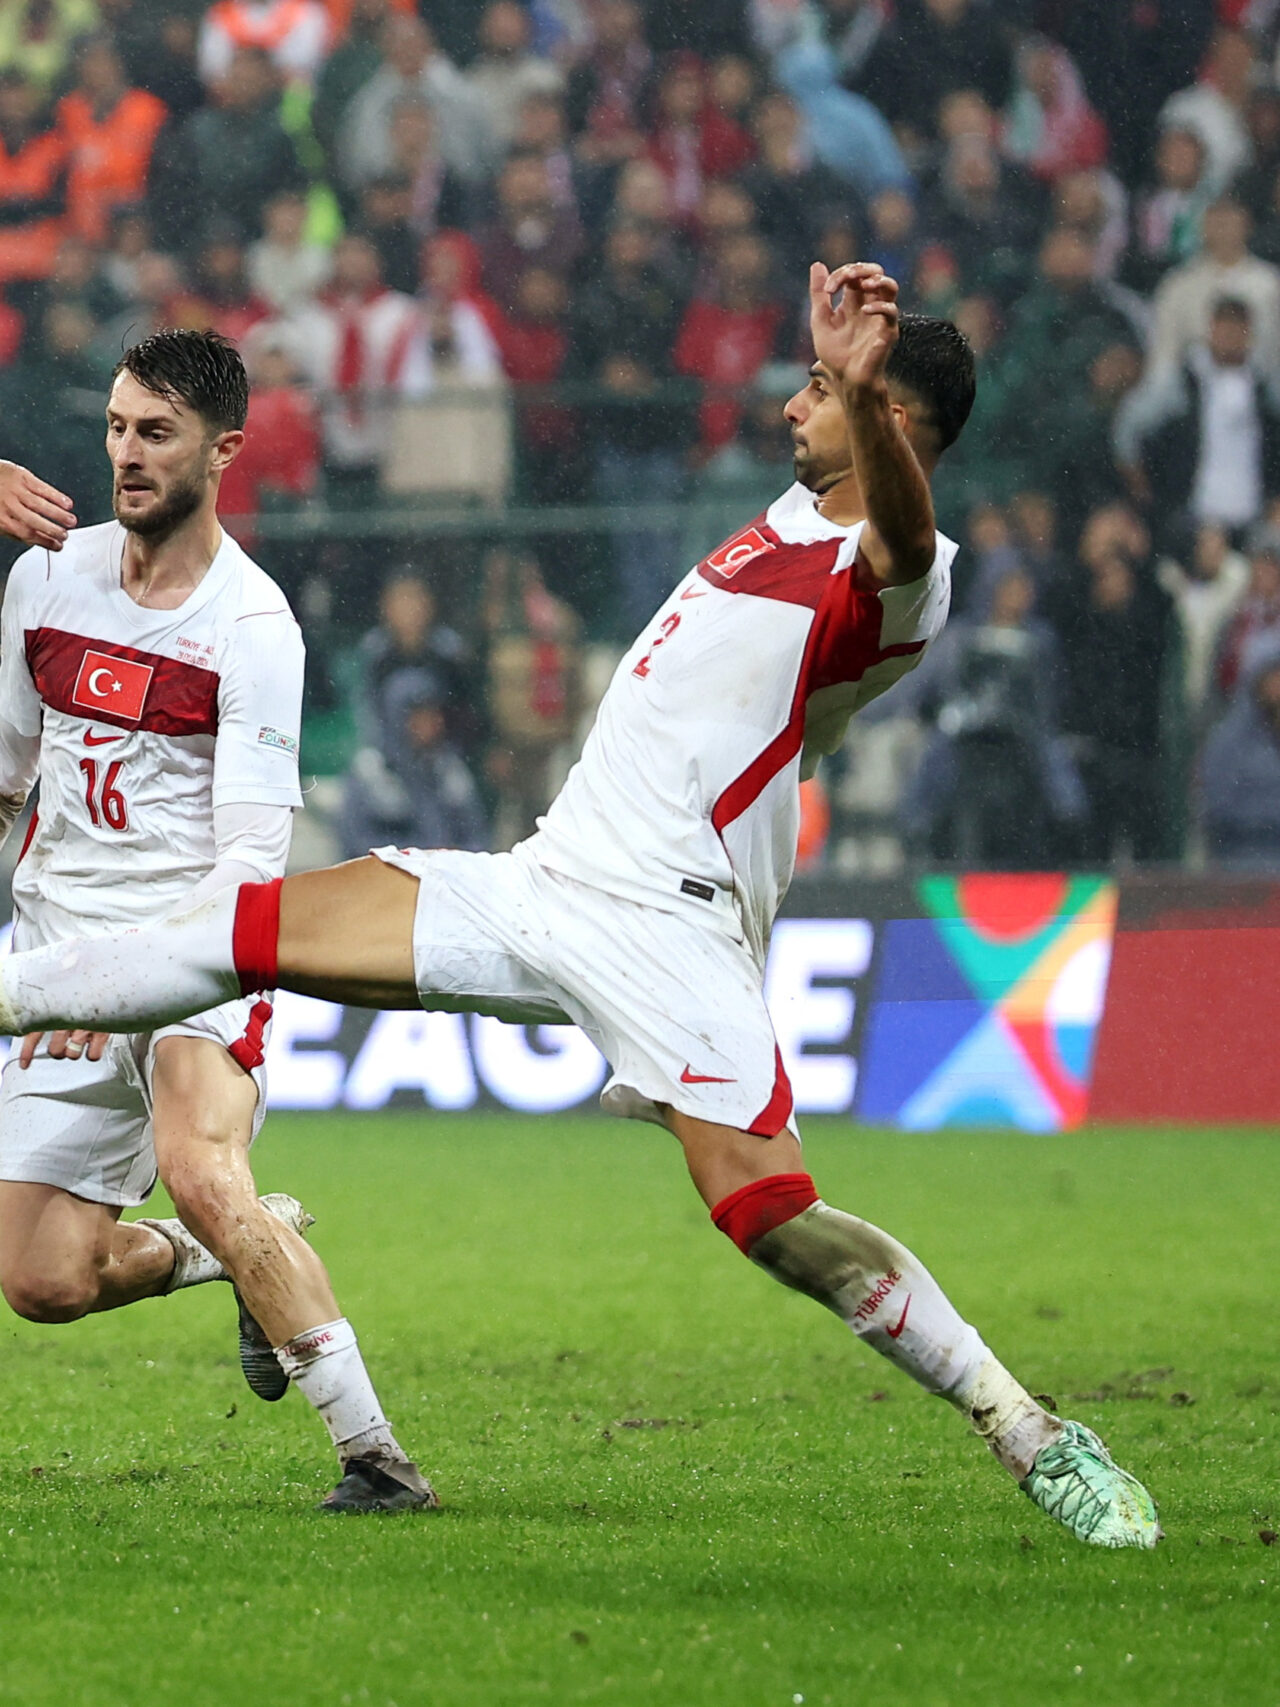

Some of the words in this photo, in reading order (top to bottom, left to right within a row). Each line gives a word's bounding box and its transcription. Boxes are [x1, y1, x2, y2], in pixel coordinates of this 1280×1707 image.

[631, 610, 681, 681] 2
[79, 757, 129, 832] 16
[854, 1266, 902, 1321] TÜRKİYE
